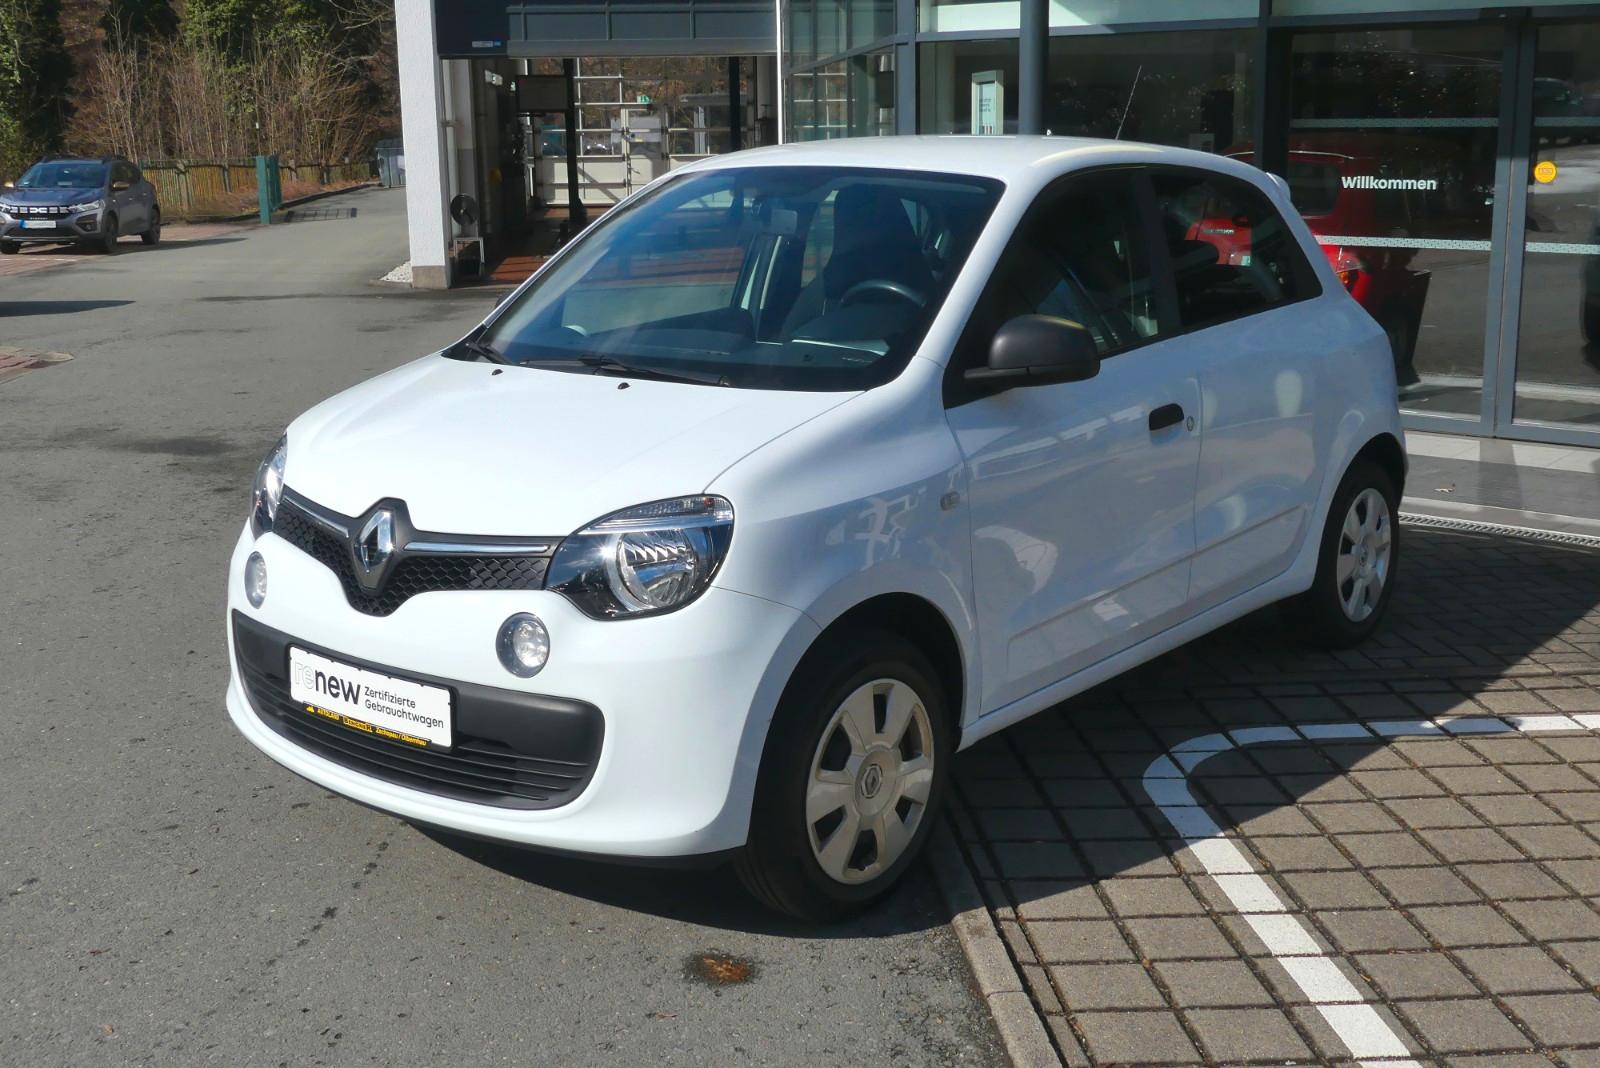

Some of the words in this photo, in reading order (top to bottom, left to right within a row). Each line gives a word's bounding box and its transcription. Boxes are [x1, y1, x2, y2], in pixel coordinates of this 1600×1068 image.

[1341, 176, 1437, 190] Willkommen
[364, 686, 416, 709] Zertifizierte
[364, 700, 444, 729] Gebrauchtwagen
